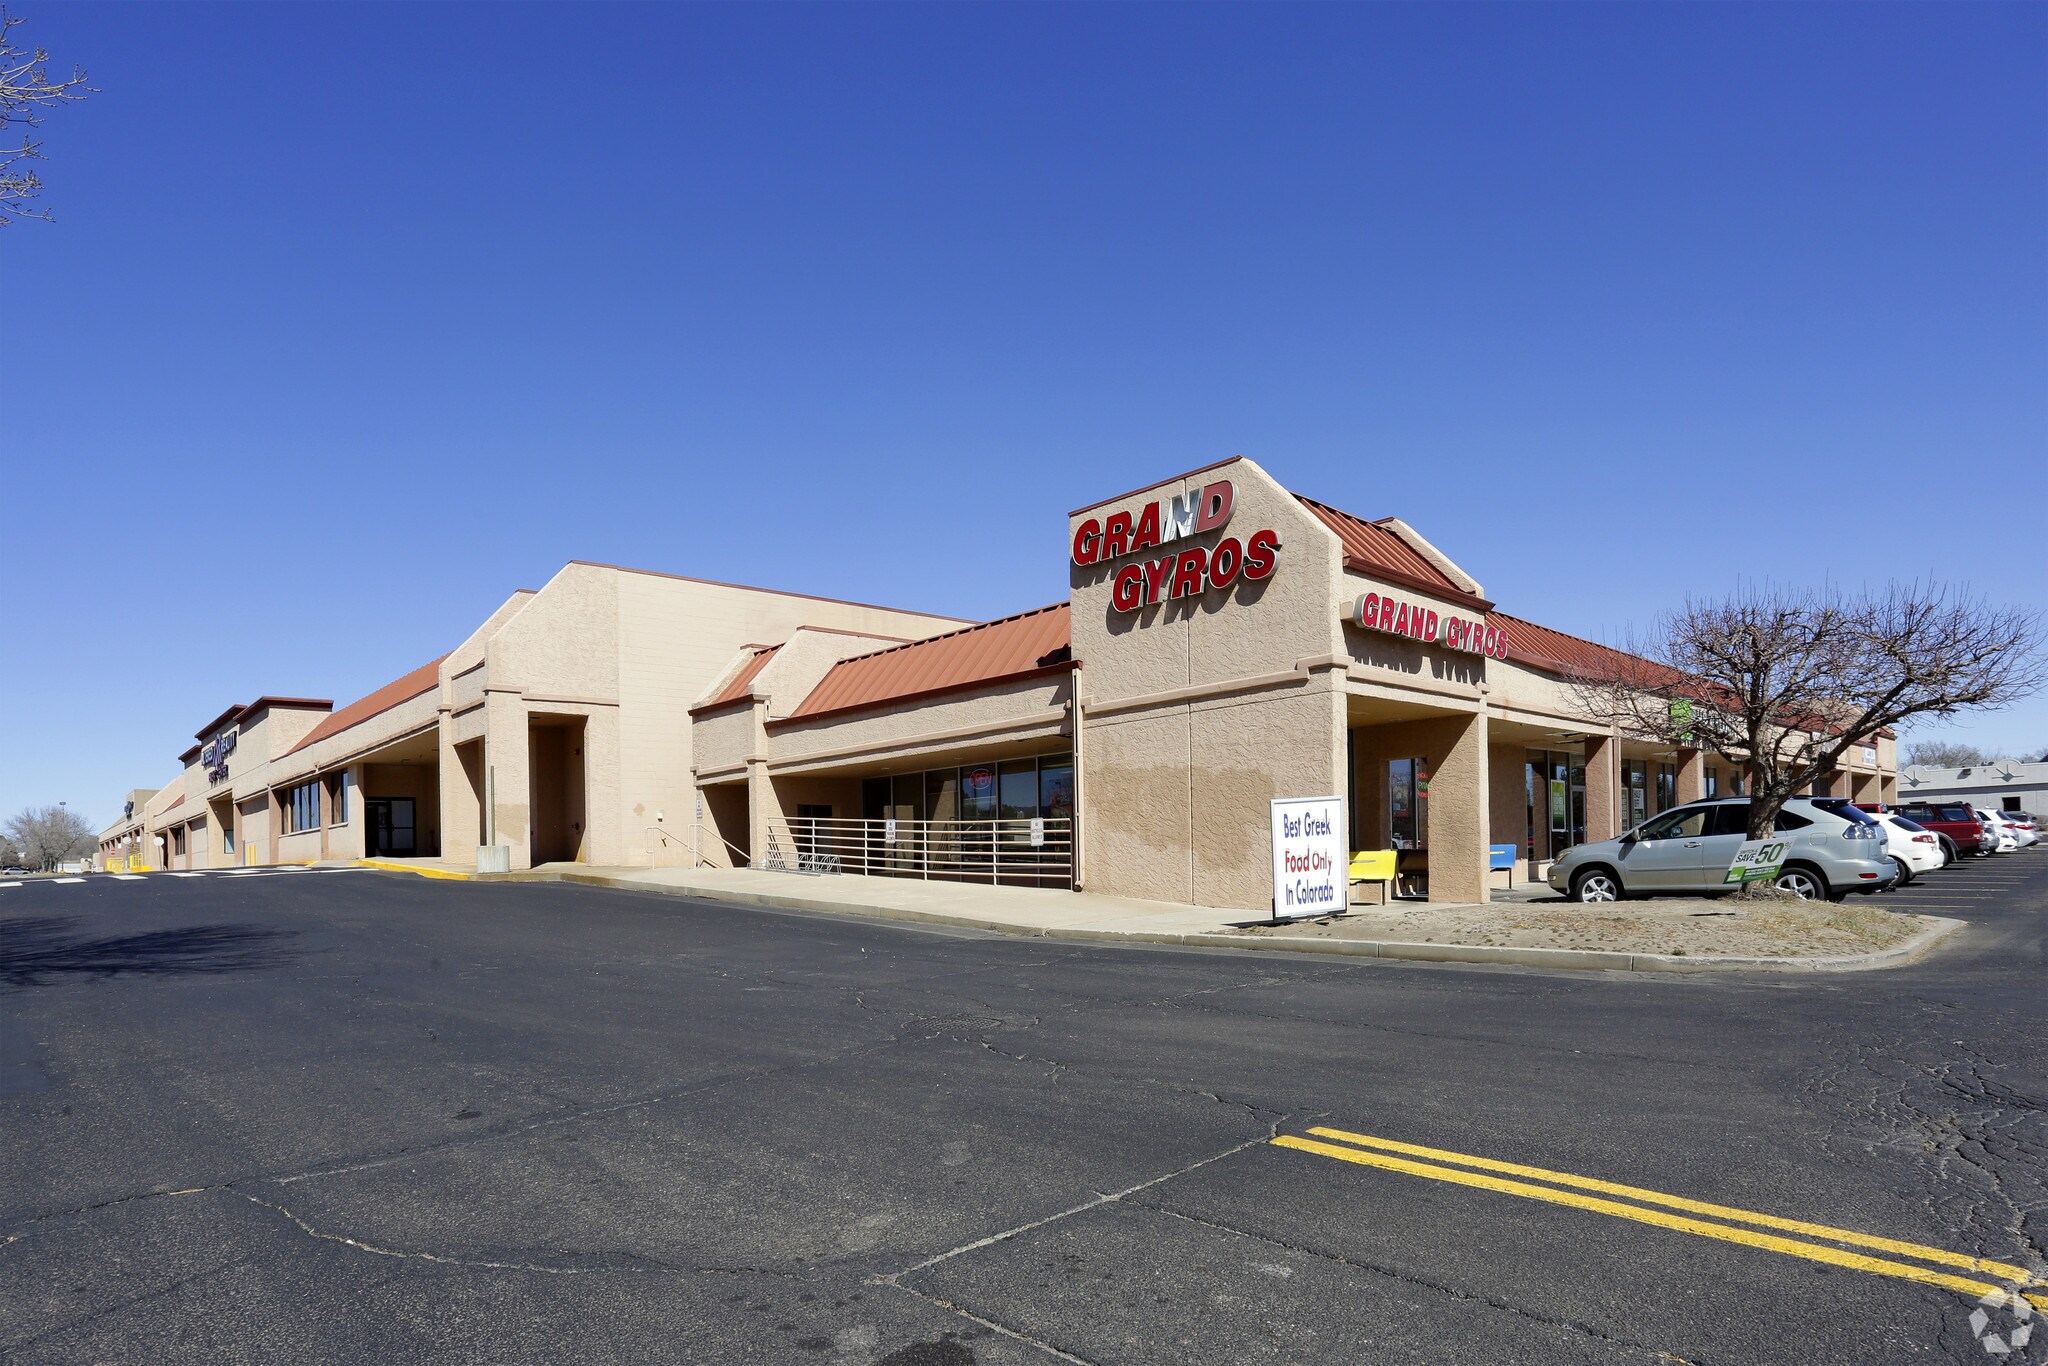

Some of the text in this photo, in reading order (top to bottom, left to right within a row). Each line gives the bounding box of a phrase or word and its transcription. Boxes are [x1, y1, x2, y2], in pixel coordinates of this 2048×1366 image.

[1072, 479, 1238, 566] GRAND
[1112, 529, 1282, 612] GYROS
[1357, 592, 1508, 659] GRAND GYROS
[969, 772, 992, 787] OPEN
[1283, 808, 1332, 838] Best Greek
[1285, 846, 1332, 876] Food Only
[1735, 841, 1793, 864] SAVE 50%
[1286, 878, 1334, 906] In Colorado
